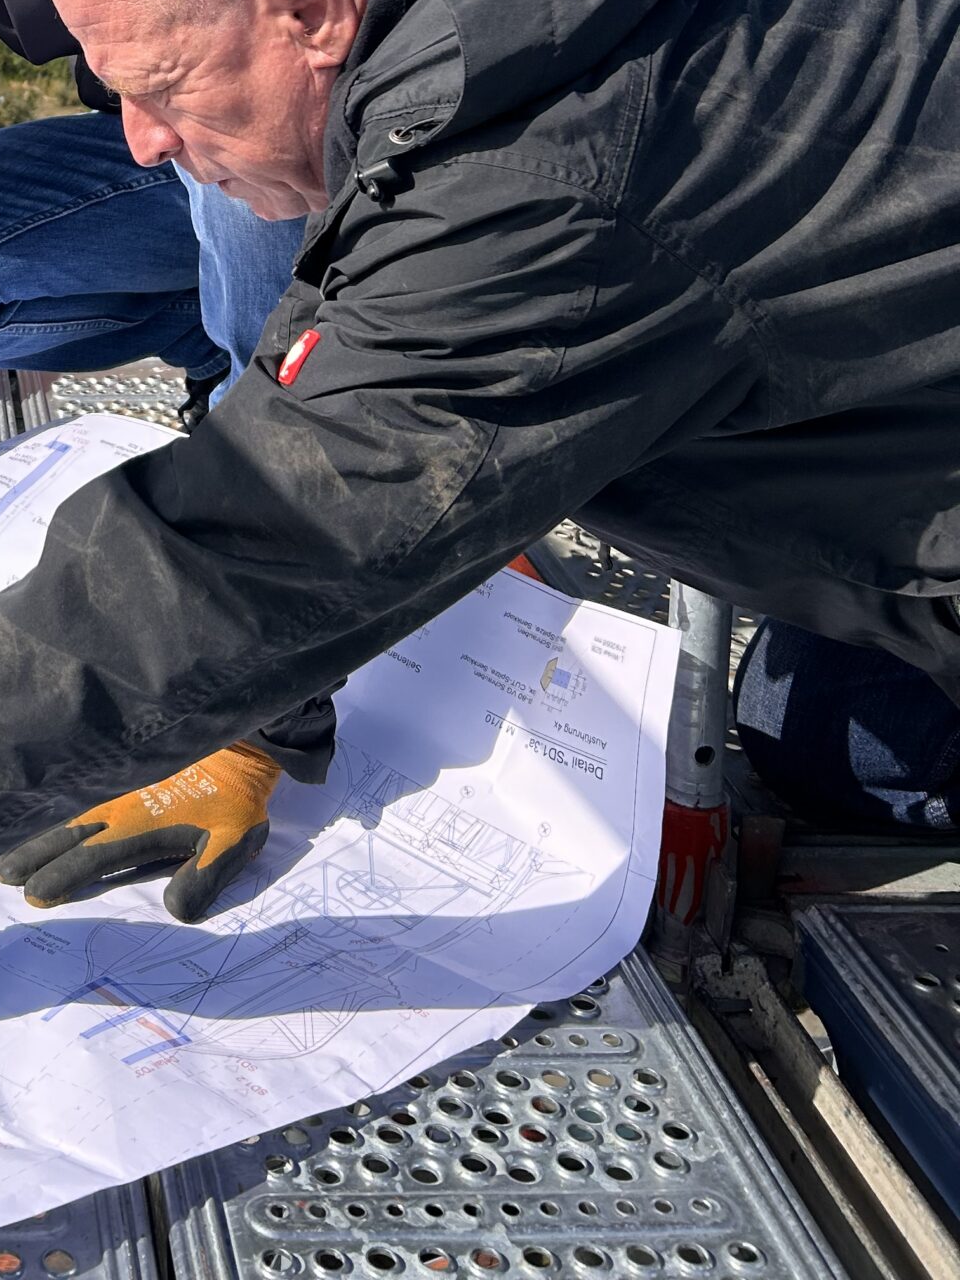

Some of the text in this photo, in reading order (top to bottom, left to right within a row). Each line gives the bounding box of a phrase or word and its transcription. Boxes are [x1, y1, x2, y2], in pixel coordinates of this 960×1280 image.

[483, 712, 504, 729] 1/10
[552, 720, 607, 749] Ausführung 4x
[569, 756, 605, 779] Detail
